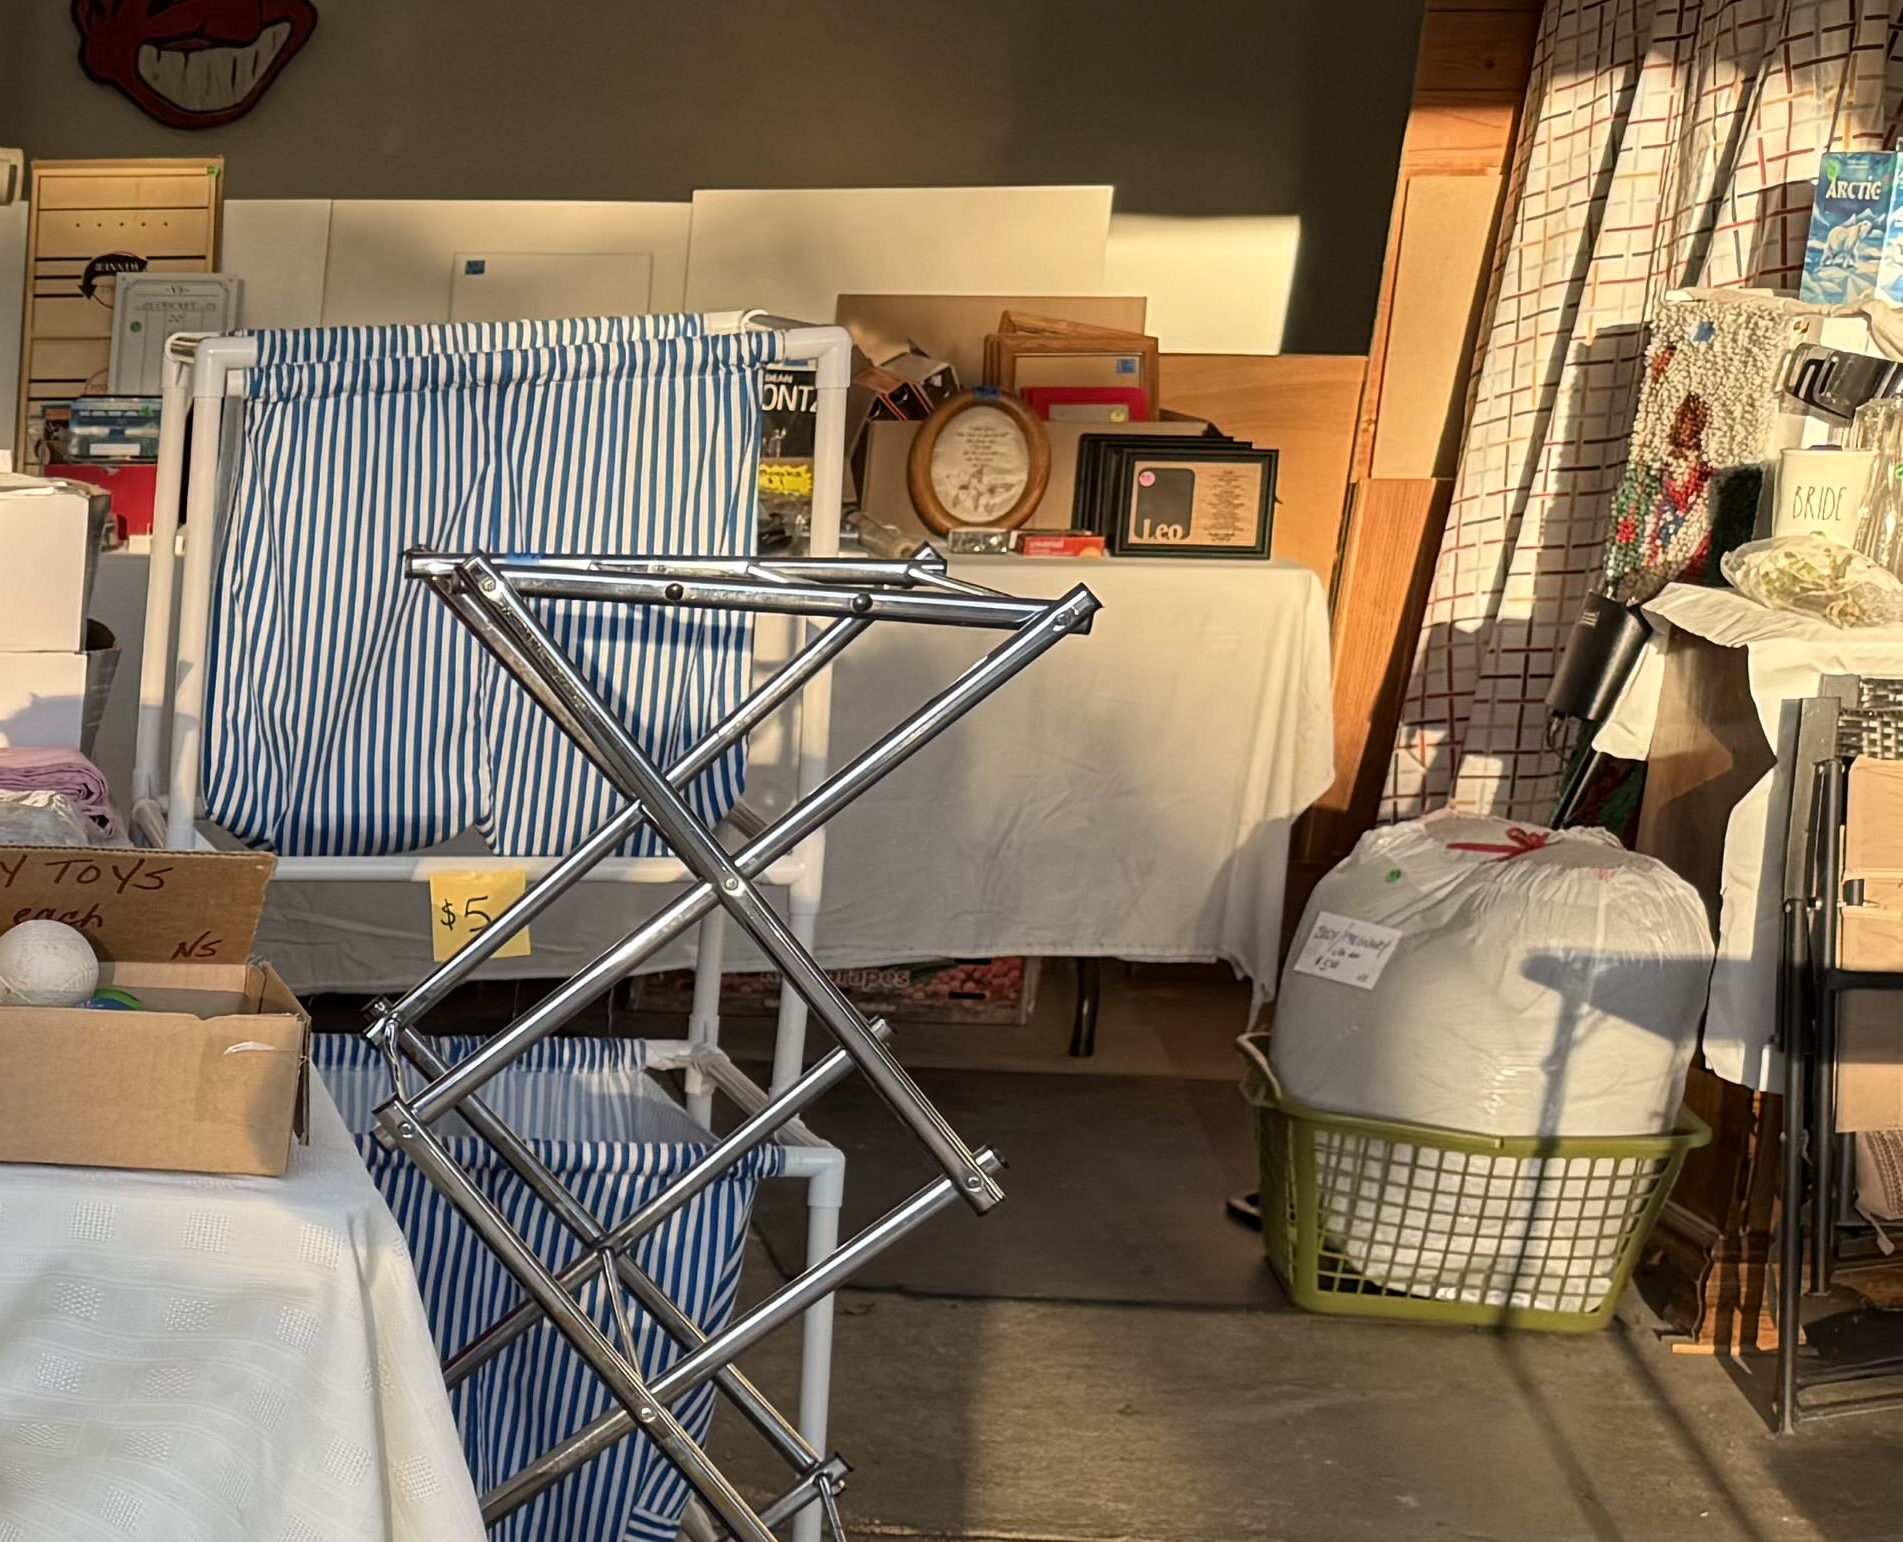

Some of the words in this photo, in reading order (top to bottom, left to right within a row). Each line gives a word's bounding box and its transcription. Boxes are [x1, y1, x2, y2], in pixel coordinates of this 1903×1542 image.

[1792, 485, 1847, 521] BRIDE
[1143, 519, 1183, 540] Leo
[45, 857, 174, 894] TOYS
[12, 903, 104, 929] each
[440, 896, 491, 932] $5
[171, 930, 222, 962] NS
